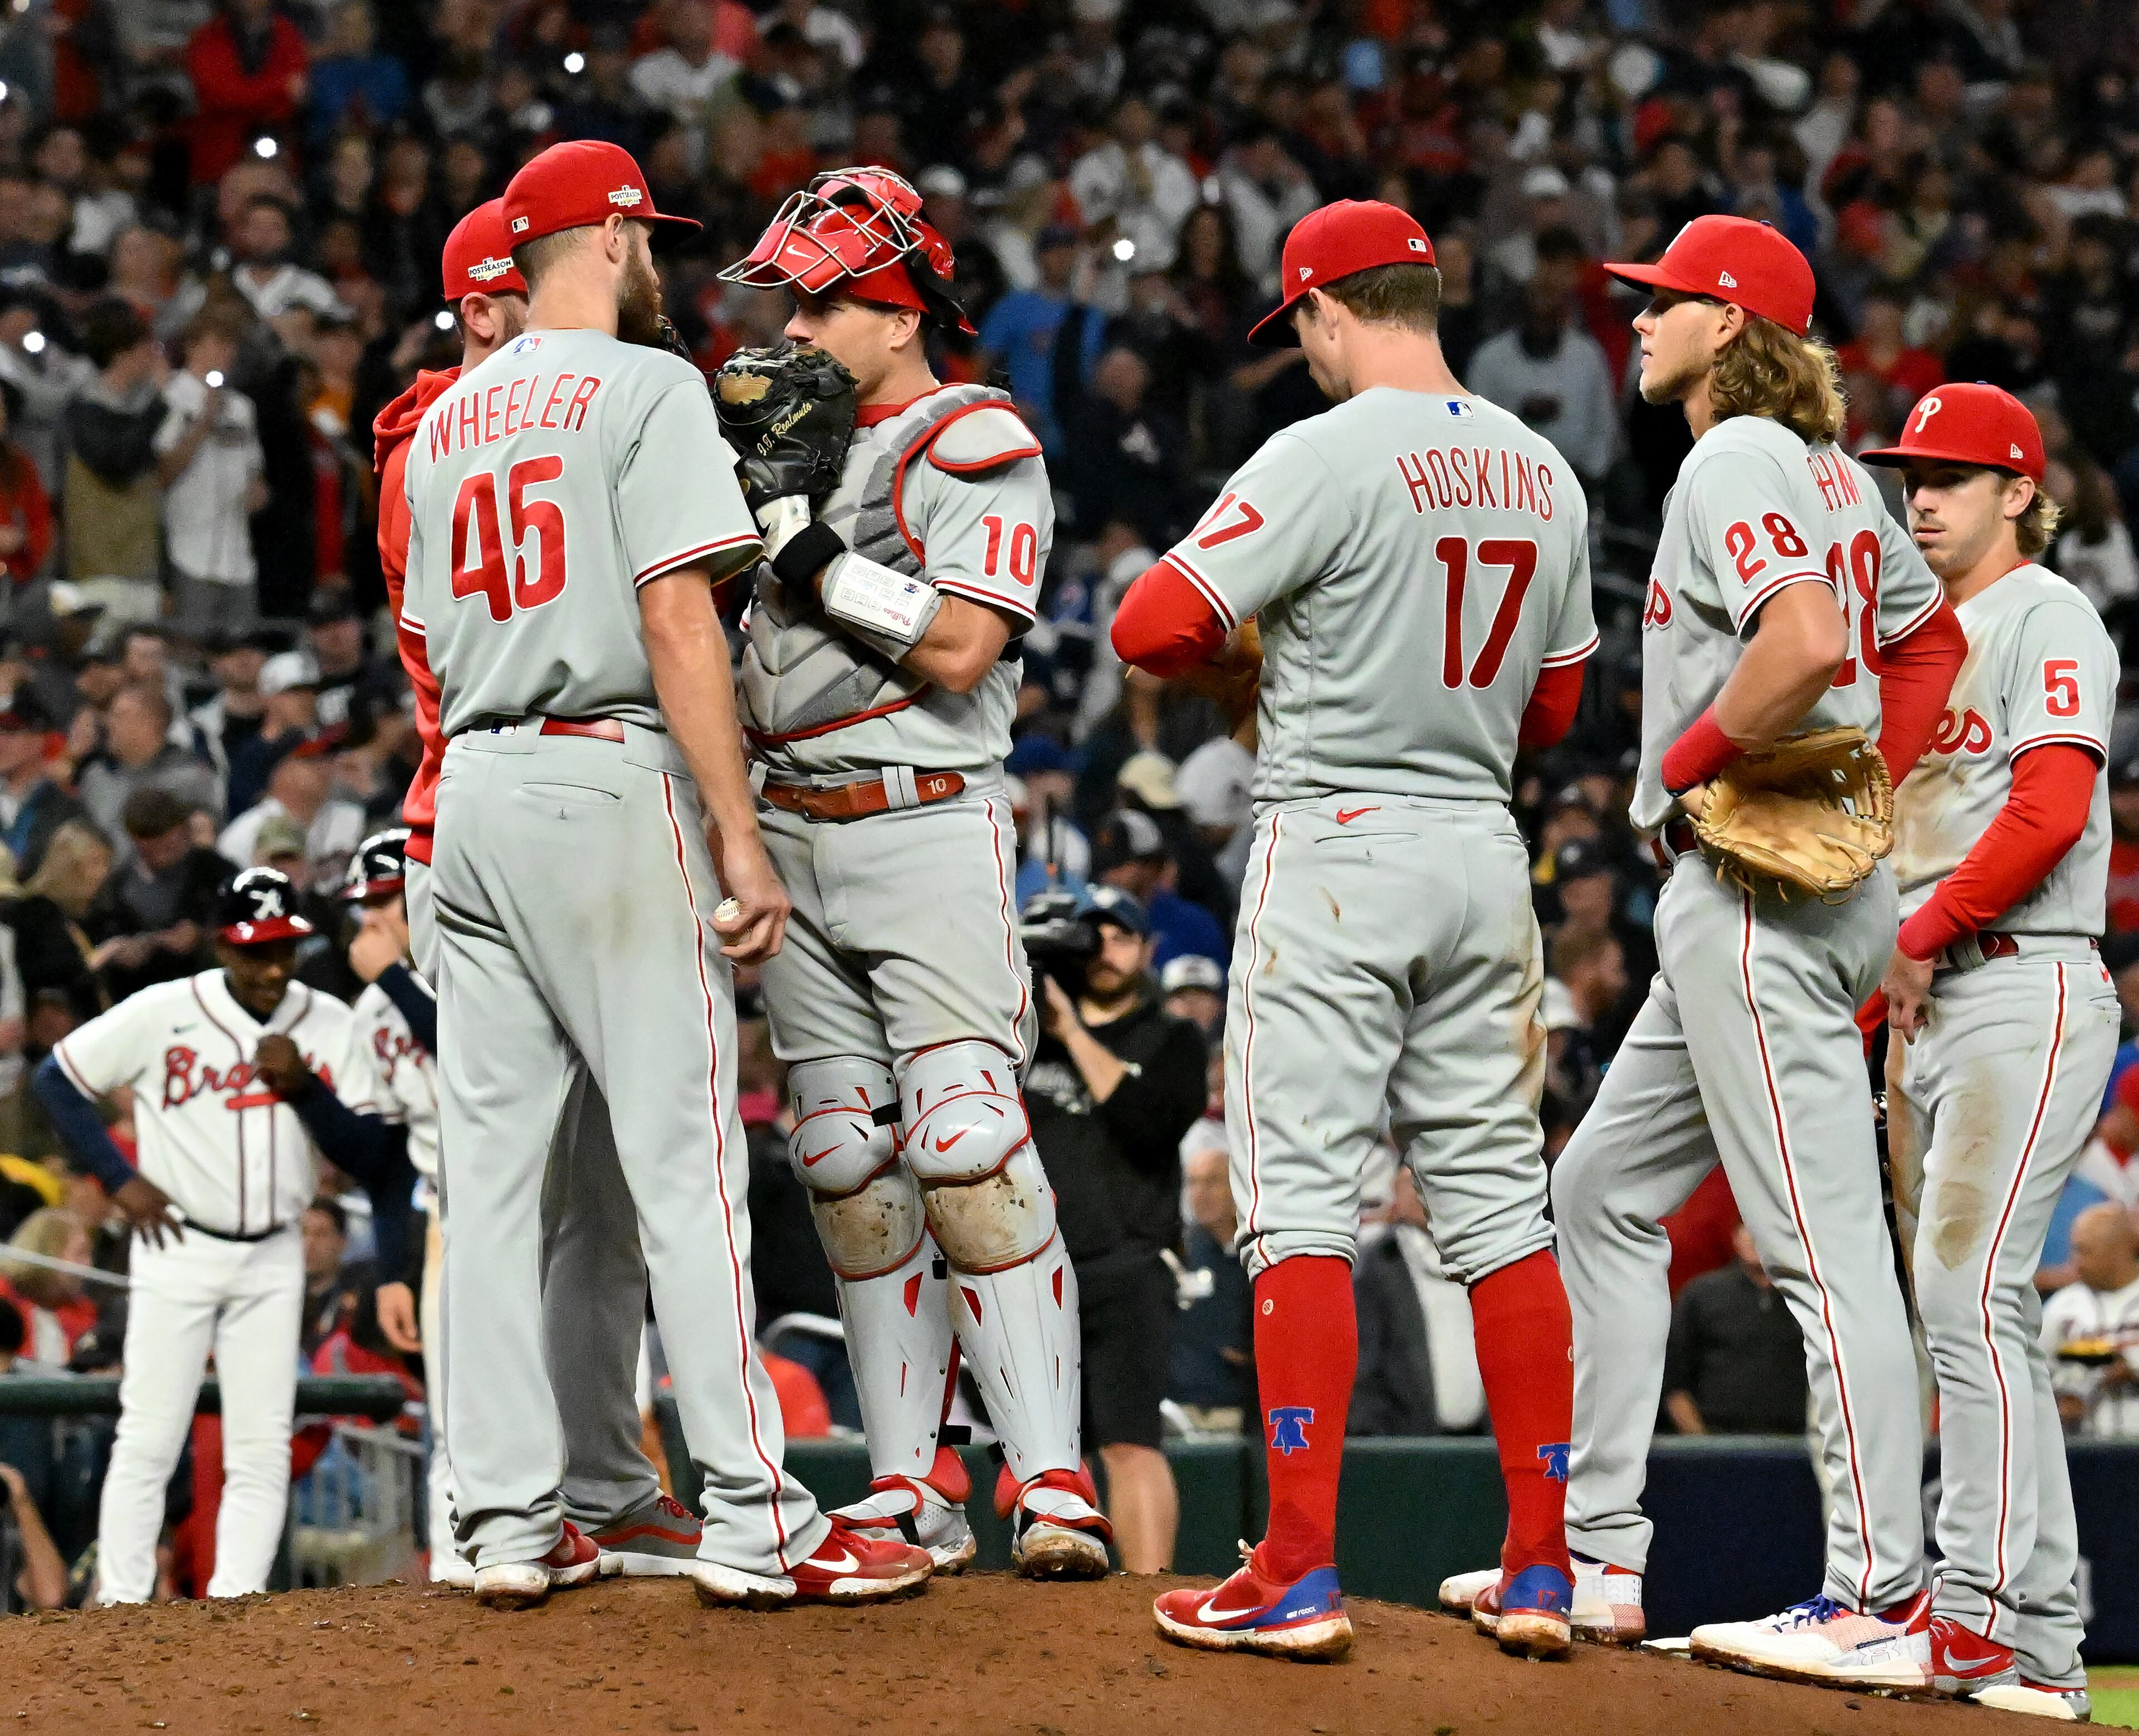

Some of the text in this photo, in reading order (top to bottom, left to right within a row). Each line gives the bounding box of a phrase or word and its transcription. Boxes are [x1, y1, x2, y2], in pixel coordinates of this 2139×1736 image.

[611, 191, 640, 201] POSTSEASON
[469, 259, 511, 276] POSTSEASON
[429, 373, 601, 466] WHEELER
[771, 402, 813, 439] Realmuto
[1915, 397, 1942, 433] P
[1396, 445, 1554, 523] HOSKINS
[1806, 450, 1863, 514] HM
[450, 453, 569, 624] 45
[980, 514, 1038, 589] 10
[1187, 491, 1266, 552] 17
[1725, 512, 1810, 588] 28
[1435, 537, 1538, 690] 17
[2042, 657, 2082, 719] 5
[927, 778, 947, 794] 10
